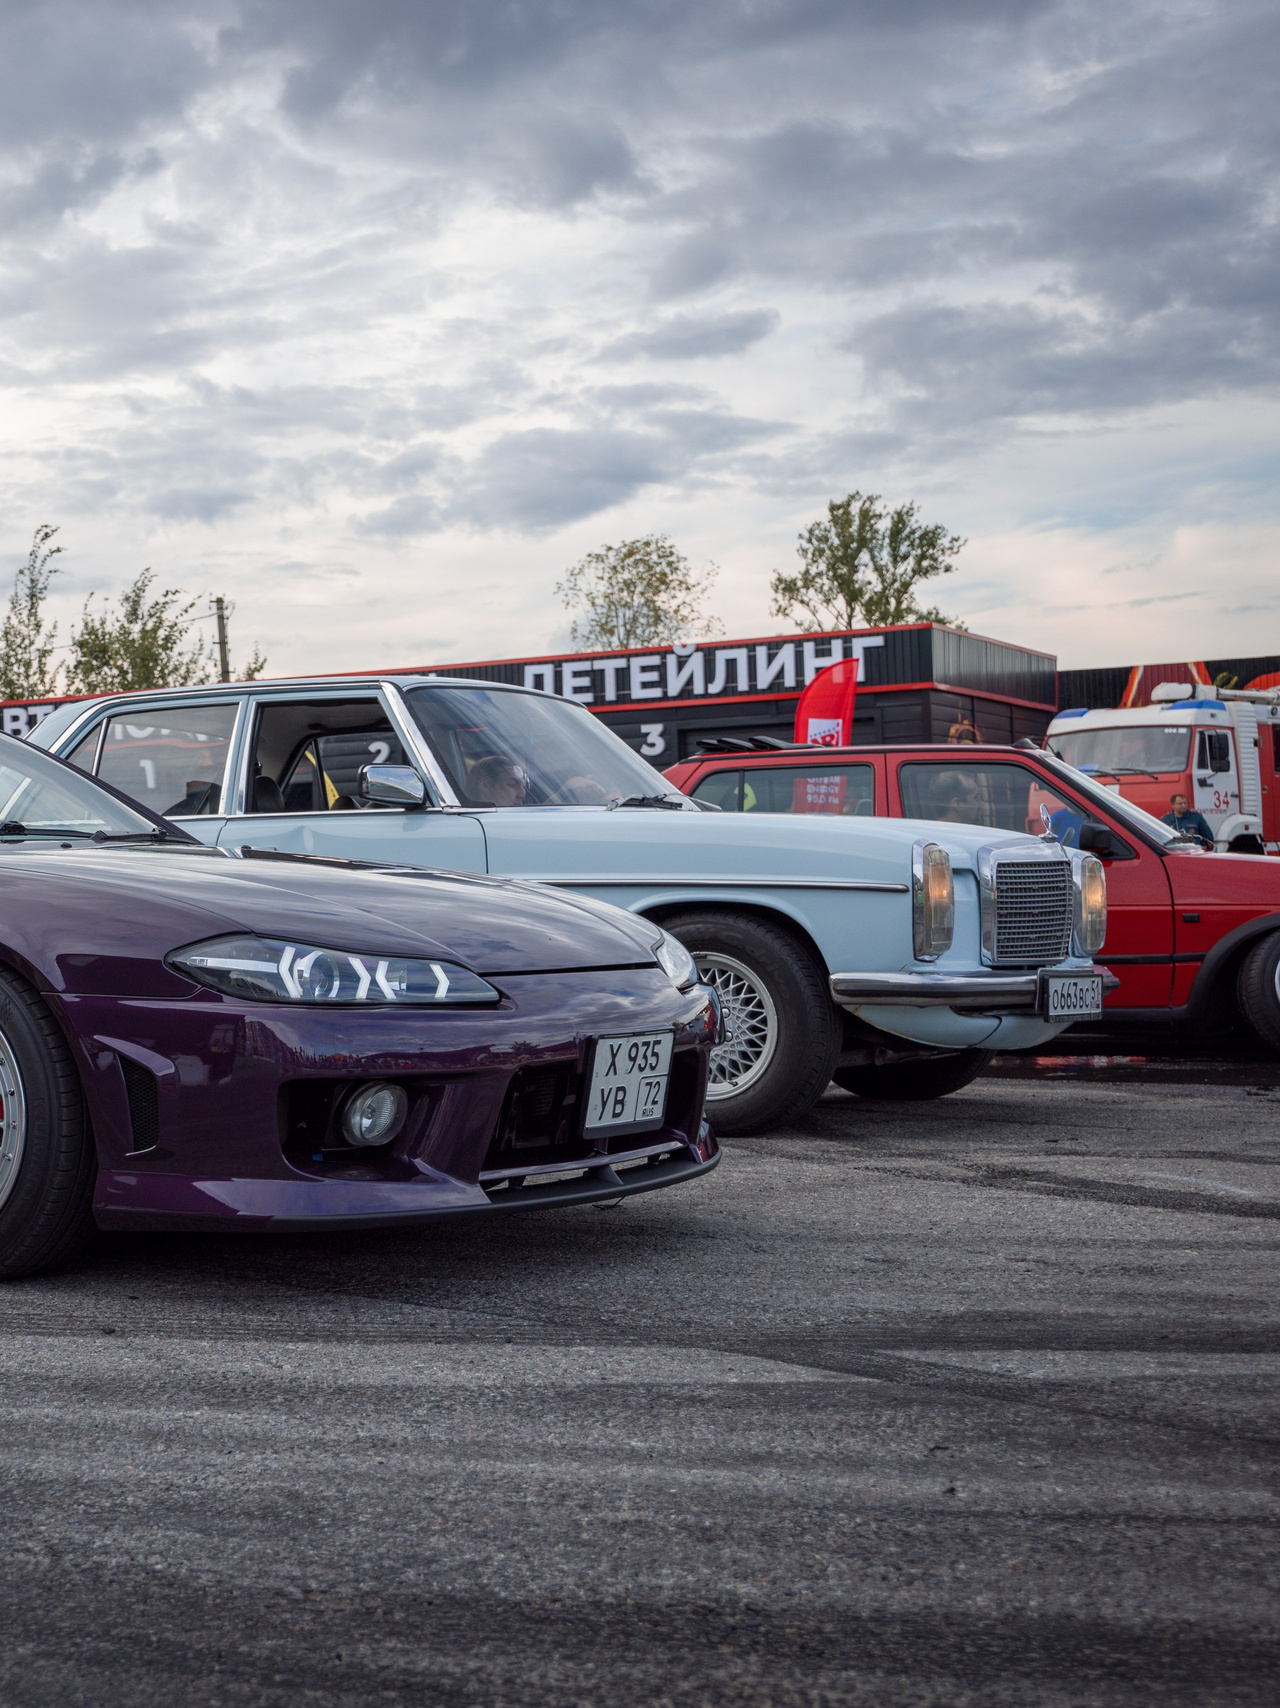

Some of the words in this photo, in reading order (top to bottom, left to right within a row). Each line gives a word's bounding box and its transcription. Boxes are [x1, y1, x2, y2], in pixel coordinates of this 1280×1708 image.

[368, 741, 390, 763] 2
[640, 724, 666, 756] 3
[140, 759, 156, 788] 1
[1213, 790, 1230, 809] 34
[627, 1039, 662, 1075] 935
[644, 1081, 661, 1106] 72
